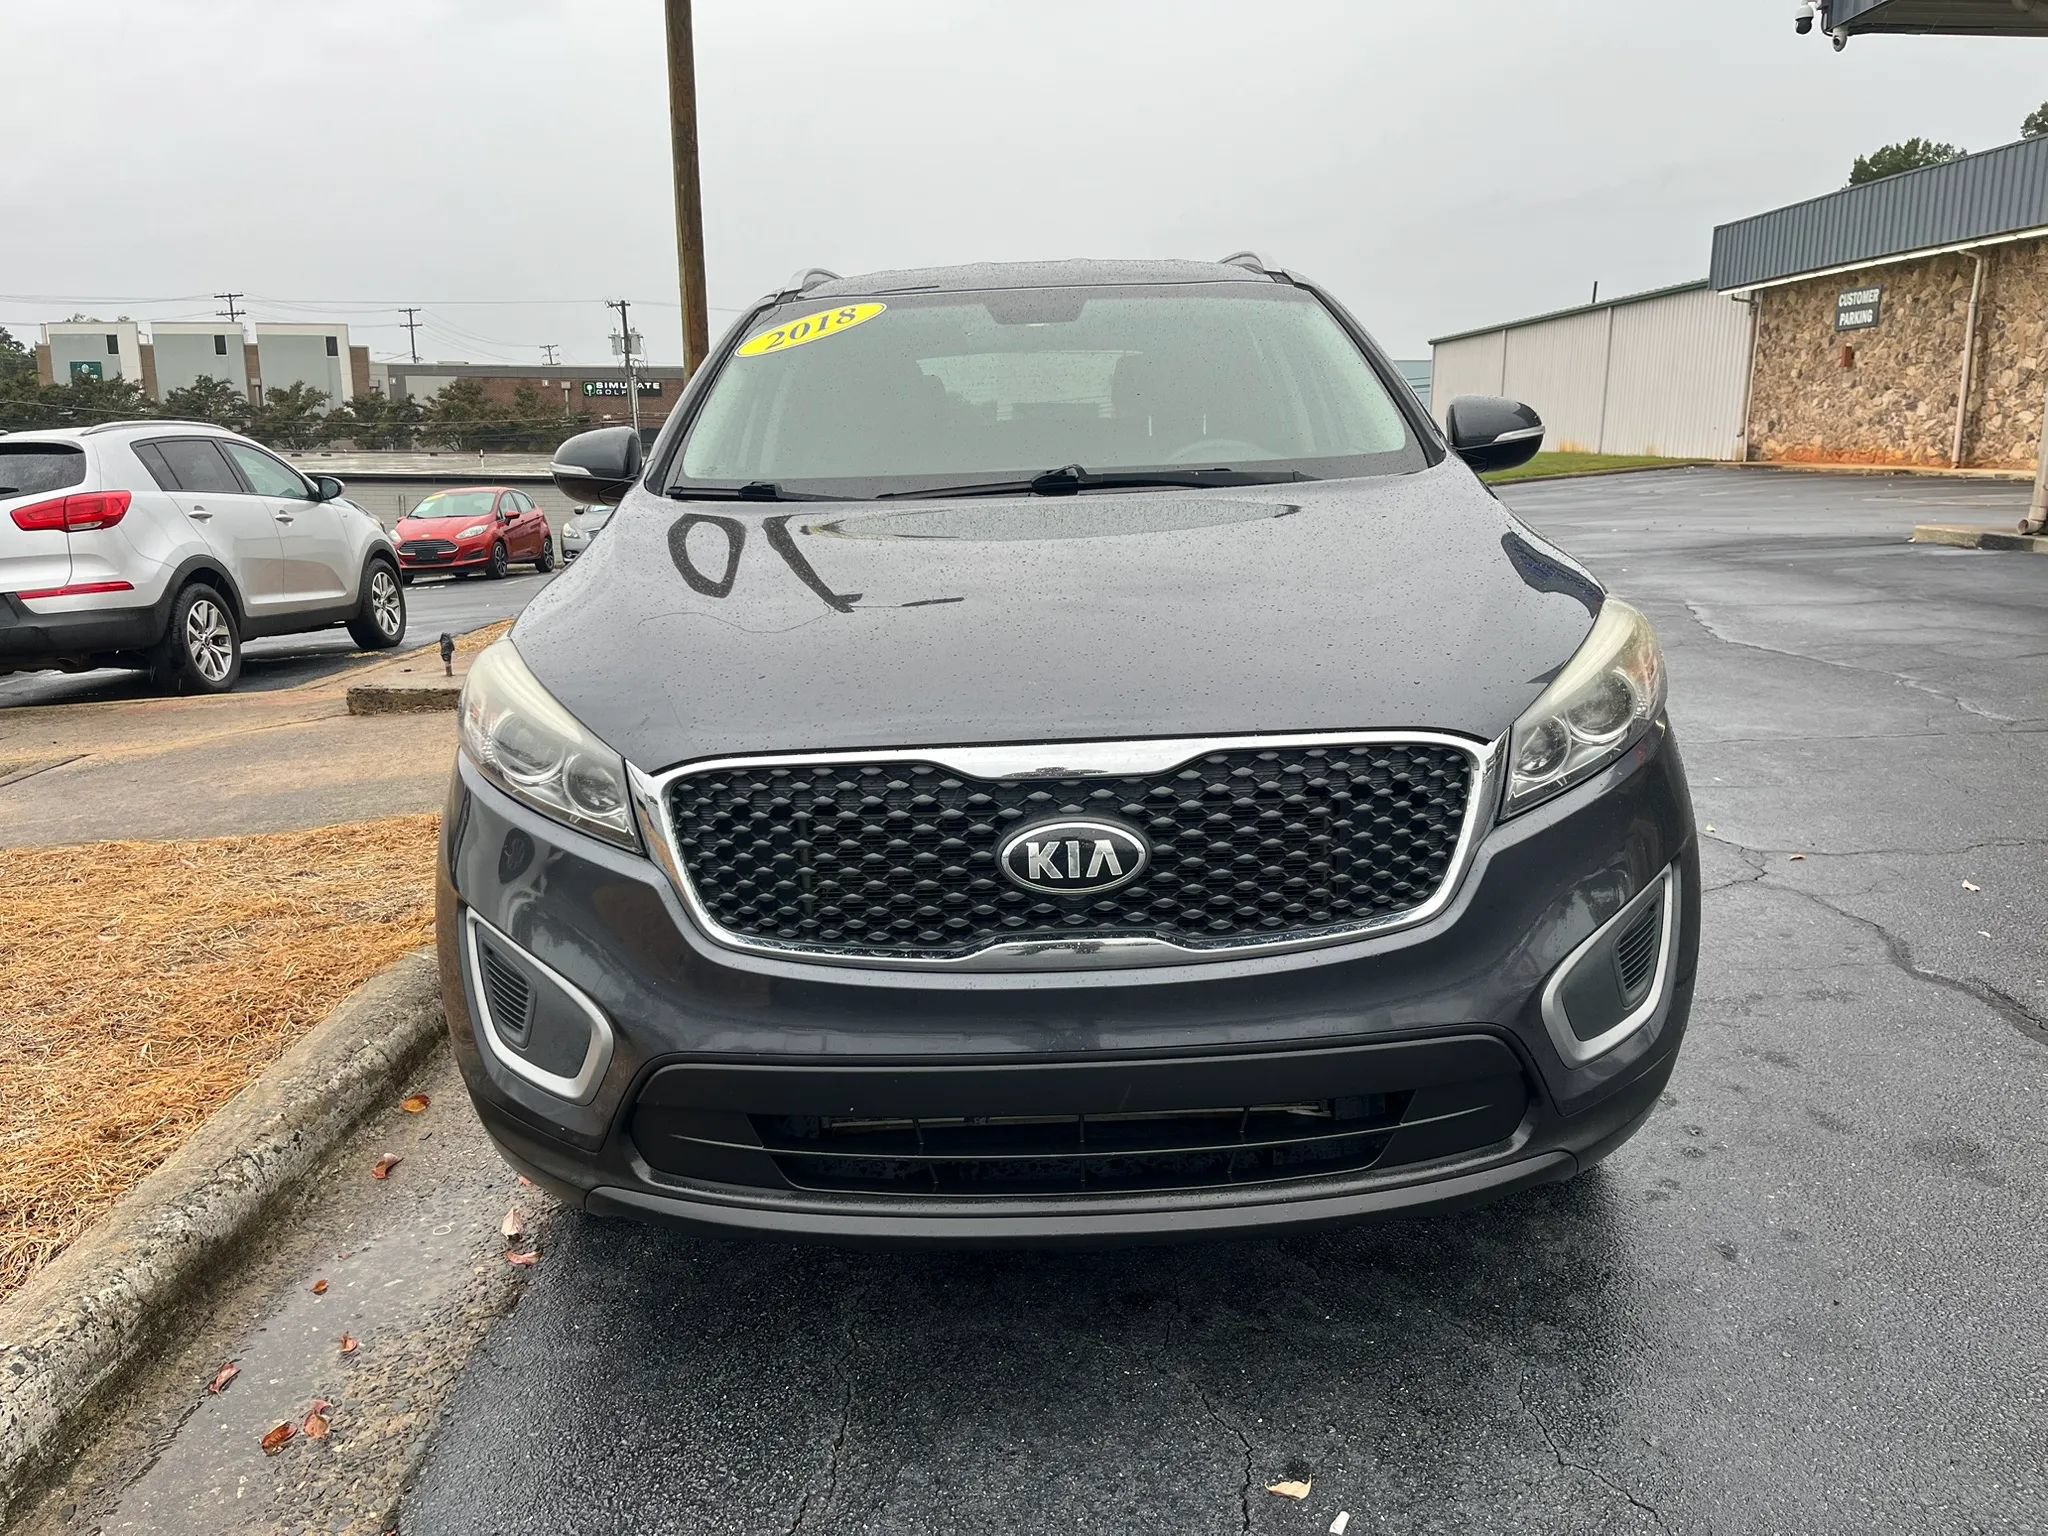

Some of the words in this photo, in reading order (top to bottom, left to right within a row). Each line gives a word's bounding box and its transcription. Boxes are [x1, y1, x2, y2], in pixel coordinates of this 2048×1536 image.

[1838, 288, 1880, 307] CUSTOMER
[1839, 309, 1873, 326] PARKING
[766, 307, 856, 350] 2018
[595, 381, 661, 390] SIMUATE
[1026, 839, 1123, 880] KIA
